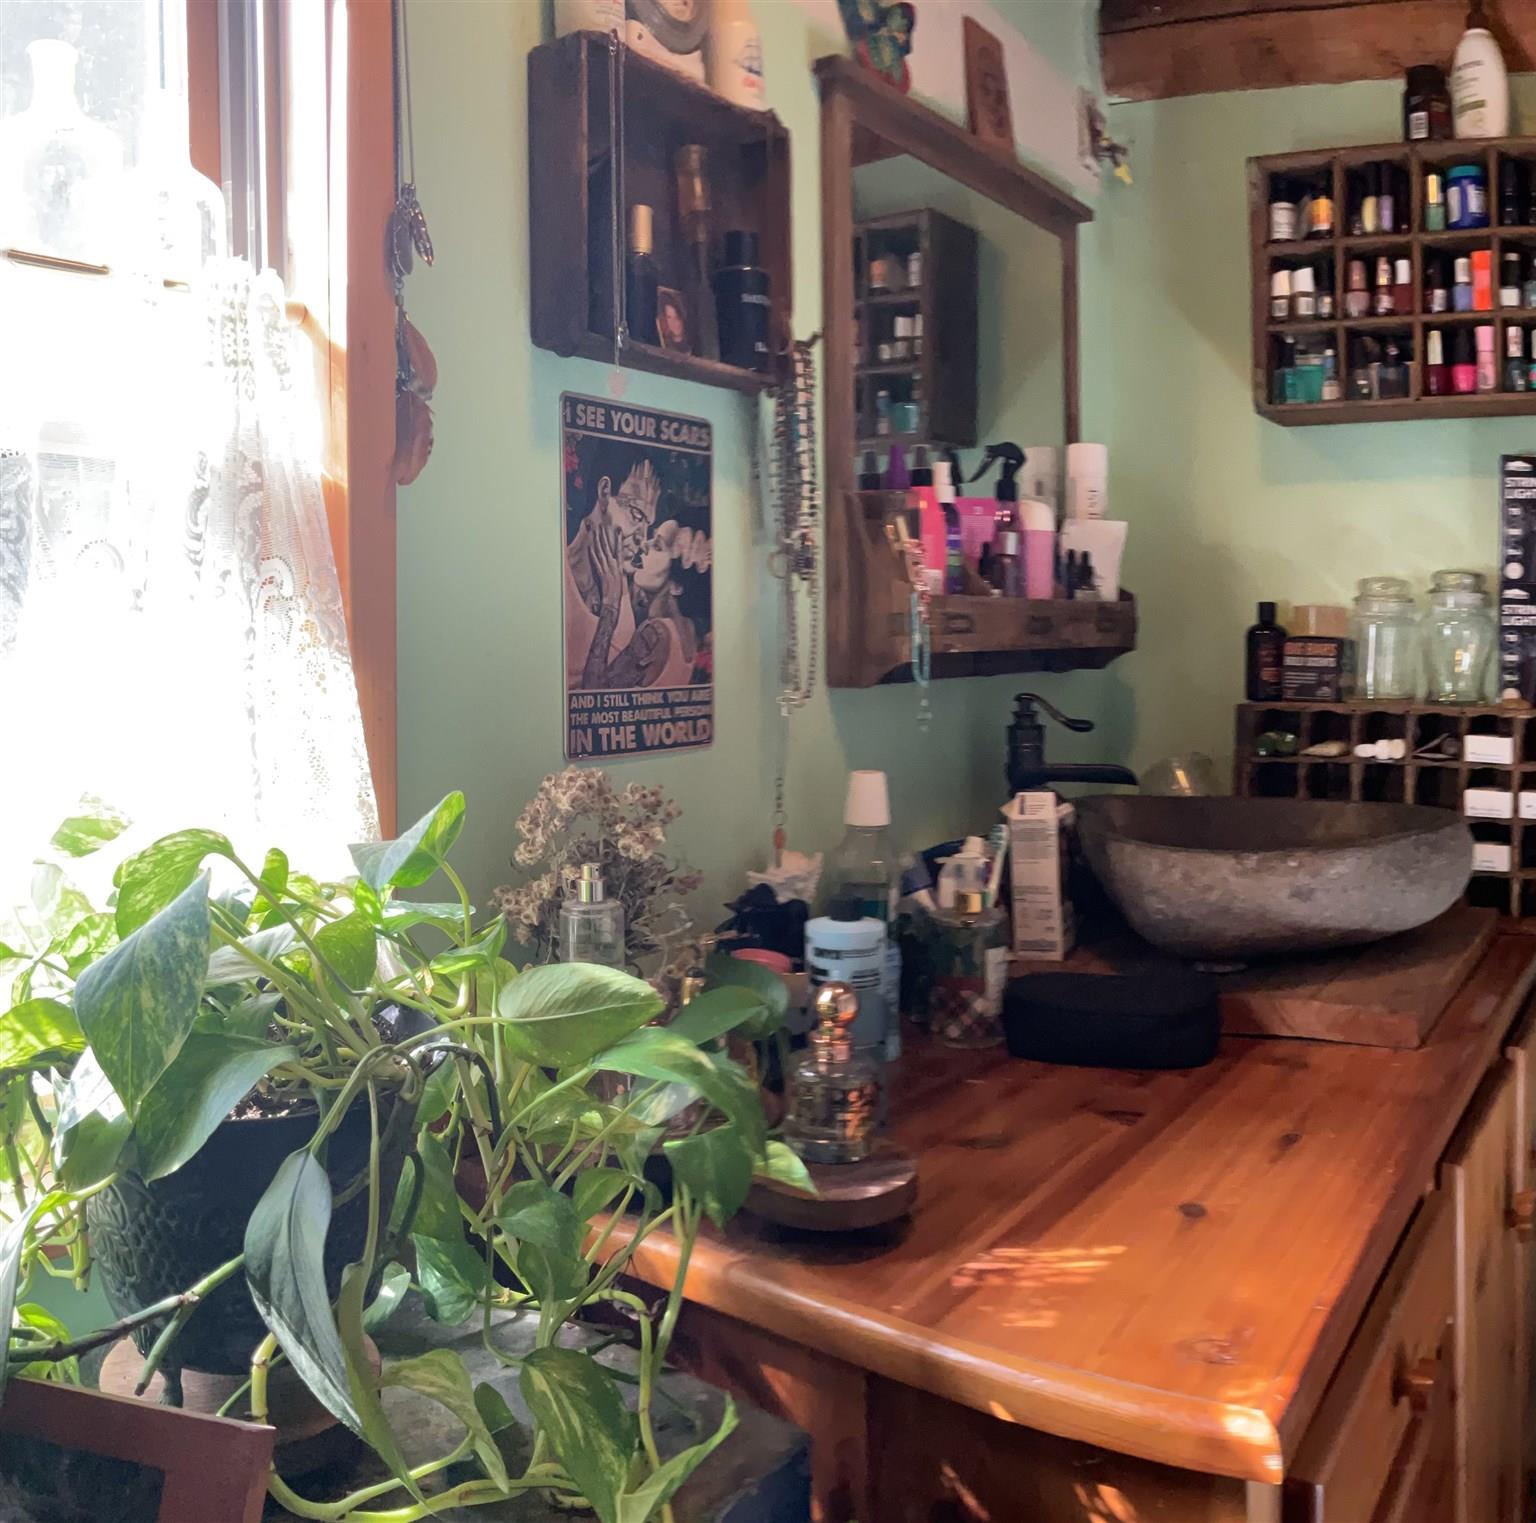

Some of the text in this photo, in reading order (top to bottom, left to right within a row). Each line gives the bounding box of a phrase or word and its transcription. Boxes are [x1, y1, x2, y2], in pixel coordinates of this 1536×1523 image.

[565, 402, 709, 447] I SEE YOUR SCARS
[571, 696, 595, 709] AND
[597, 694, 601, 707] I
[604, 693, 629, 707] STILL
[632, 691, 664, 705] THINK
[570, 713, 589, 726] THE
[591, 711, 619, 725] MOST
[622, 708, 671, 721] BEAUTIFUL
[570, 719, 711, 754] IN THE WORLD
